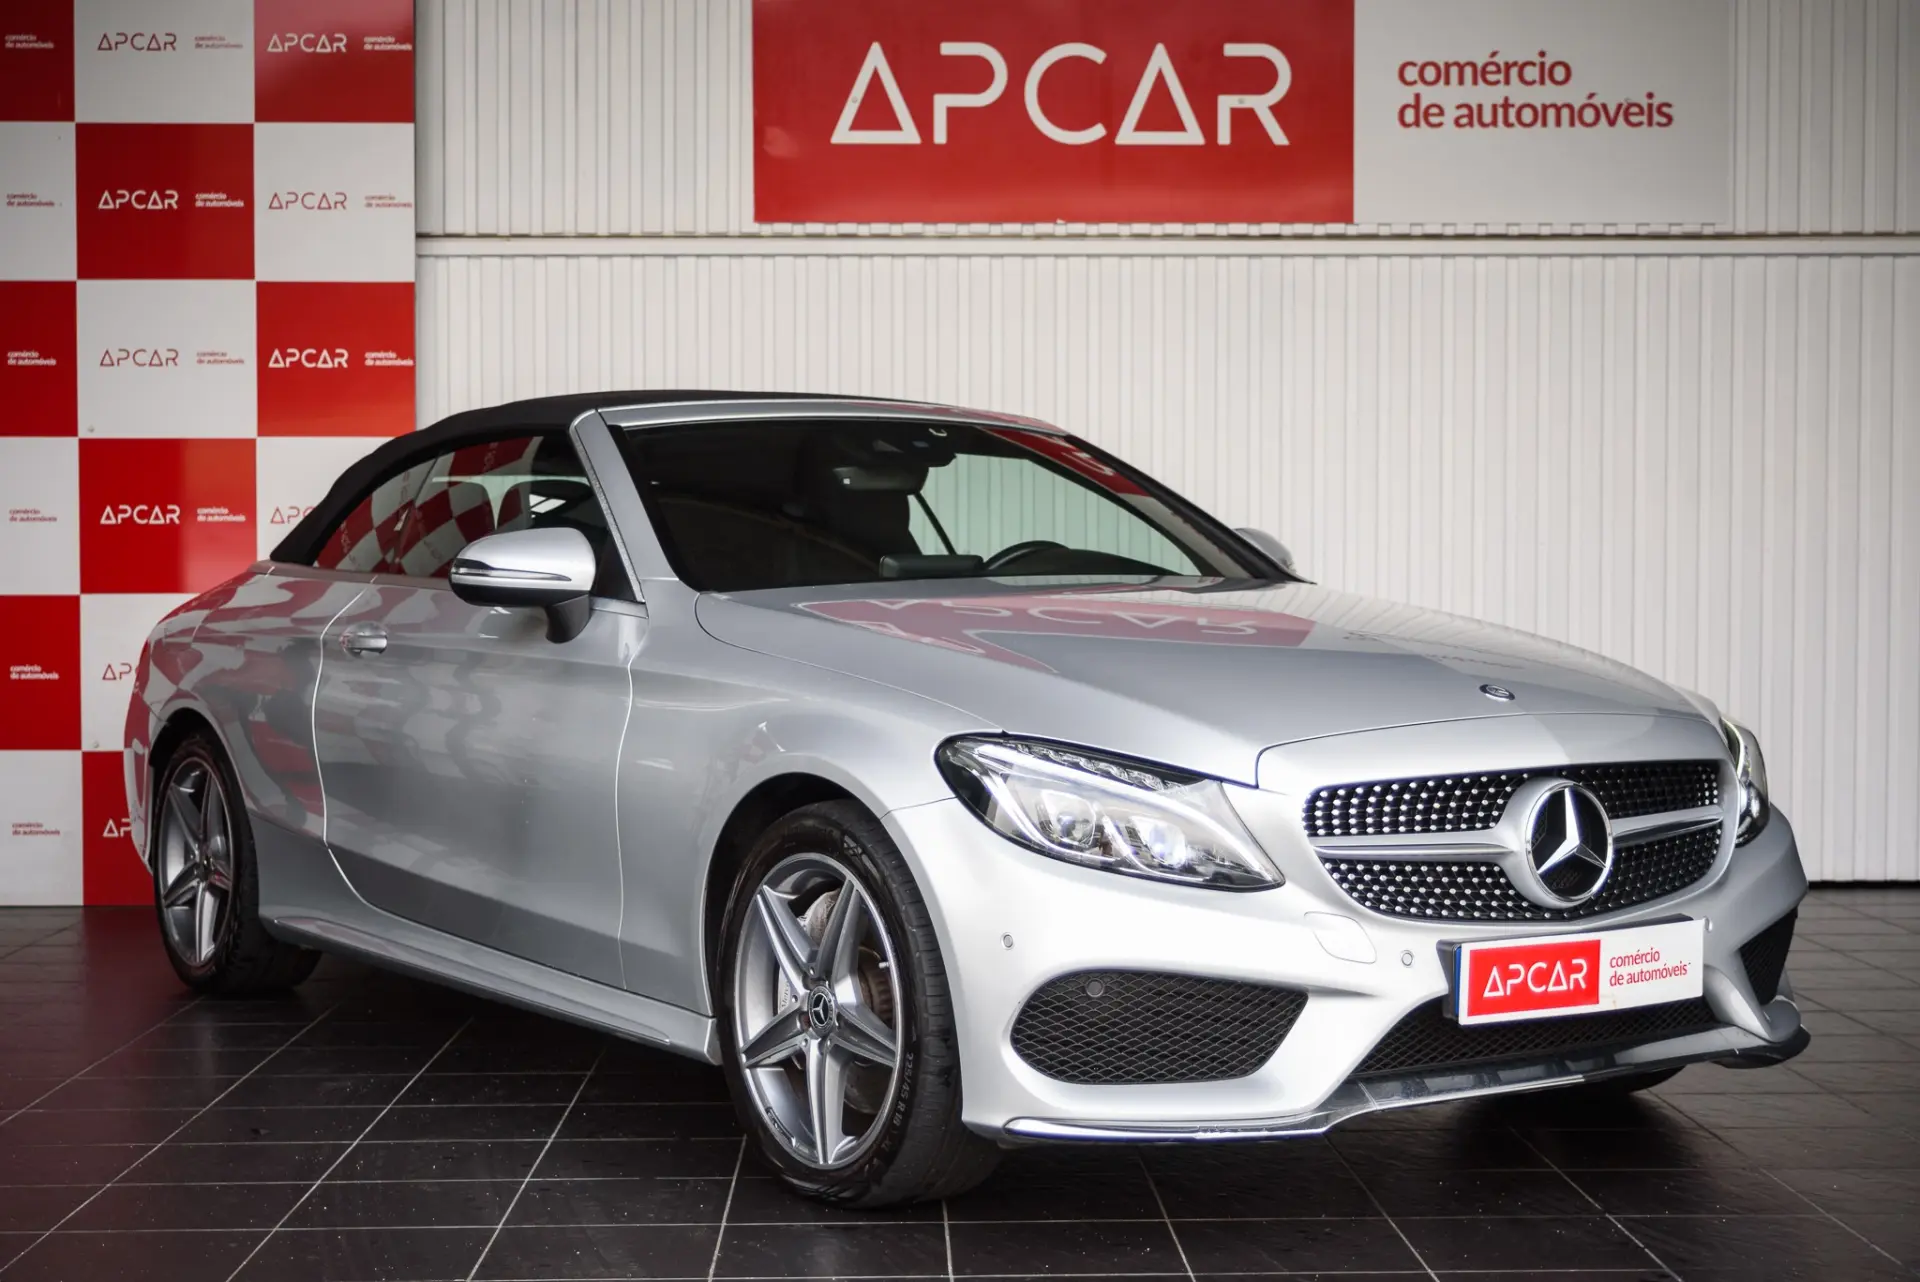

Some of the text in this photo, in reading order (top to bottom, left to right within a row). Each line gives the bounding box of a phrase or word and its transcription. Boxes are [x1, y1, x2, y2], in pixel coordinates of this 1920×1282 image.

[5, 41, 15, 49] de
[97, 32, 176, 51] APCAR
[267, 33, 347, 53] APCAR
[1398, 50, 1572, 86] comércio
[830, 42, 1292, 146] APCAR
[1398, 91, 1674, 128] de automóveis
[98, 190, 178, 209] APCAR
[269, 192, 347, 210] APCAR
[8, 358, 16, 366] de
[100, 349, 178, 367] APCAR
[269, 348, 348, 368] APCAR
[364, 358, 374, 366] de
[100, 505, 180, 524] APCAR
[197, 514, 206, 522] de
[10, 672, 19, 680] de
[1609, 946, 1660, 968] comércio
[1483, 959, 1588, 997] APCAR
[1609, 960, 1688, 987] de automóveis
